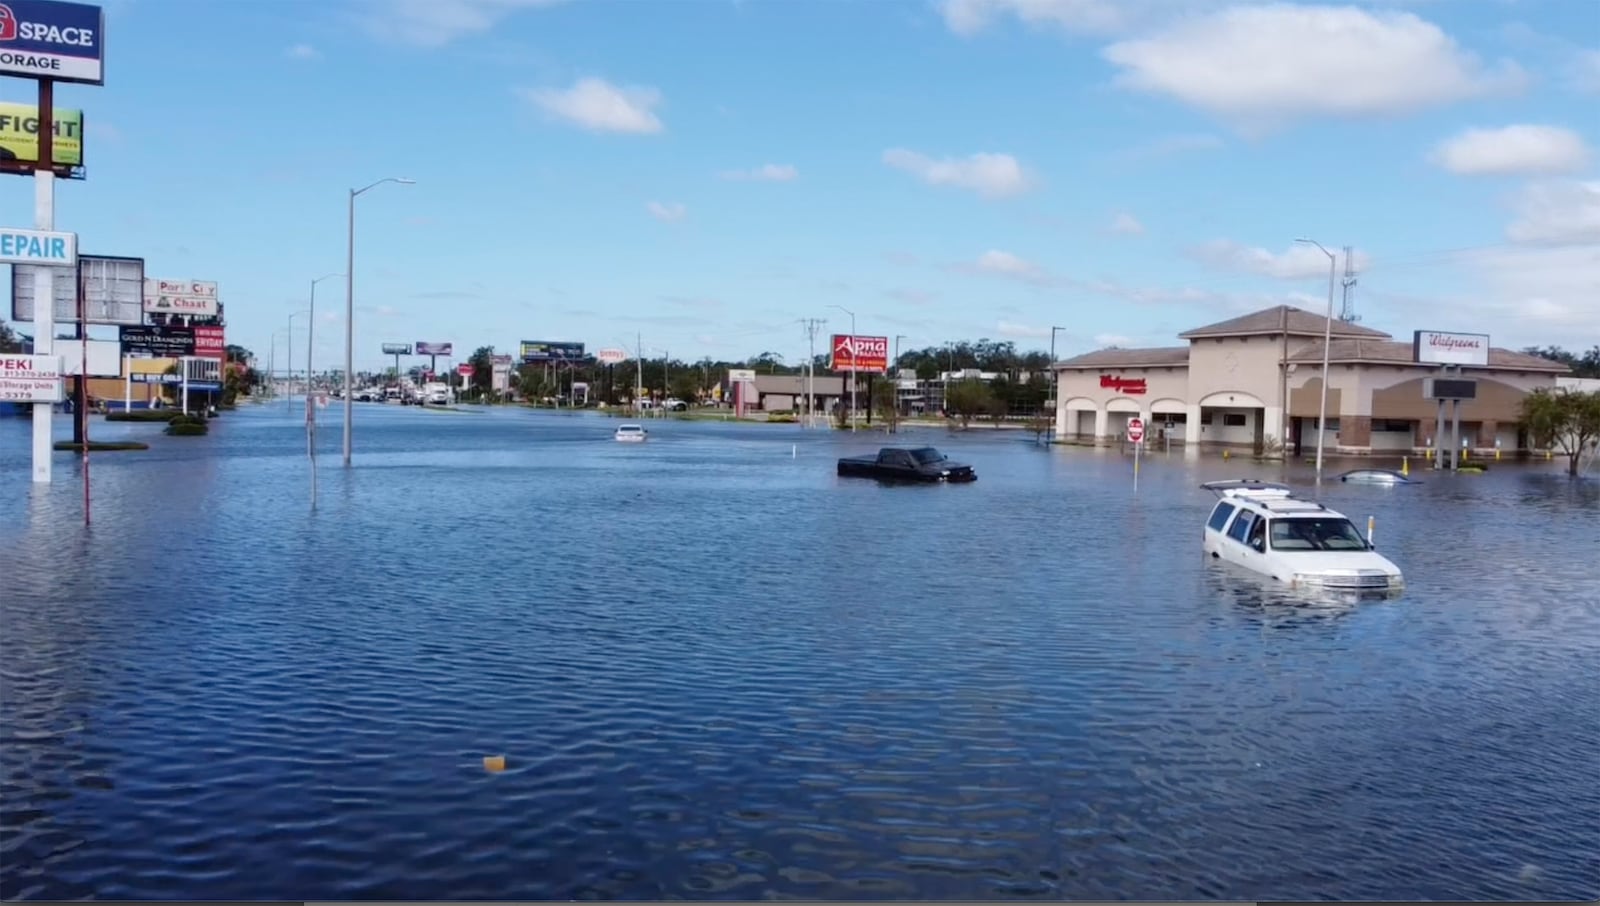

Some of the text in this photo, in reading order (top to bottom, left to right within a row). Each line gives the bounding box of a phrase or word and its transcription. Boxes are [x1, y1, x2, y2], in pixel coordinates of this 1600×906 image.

[19, 21, 93, 47] SPACE
[0, 53, 61, 70] ORAGE
[1, 233, 65, 258] EPAIR
[174, 298, 207, 308] Chaat
[835, 337, 886, 355] Apna
[1429, 333, 1480, 350] Walgreens
